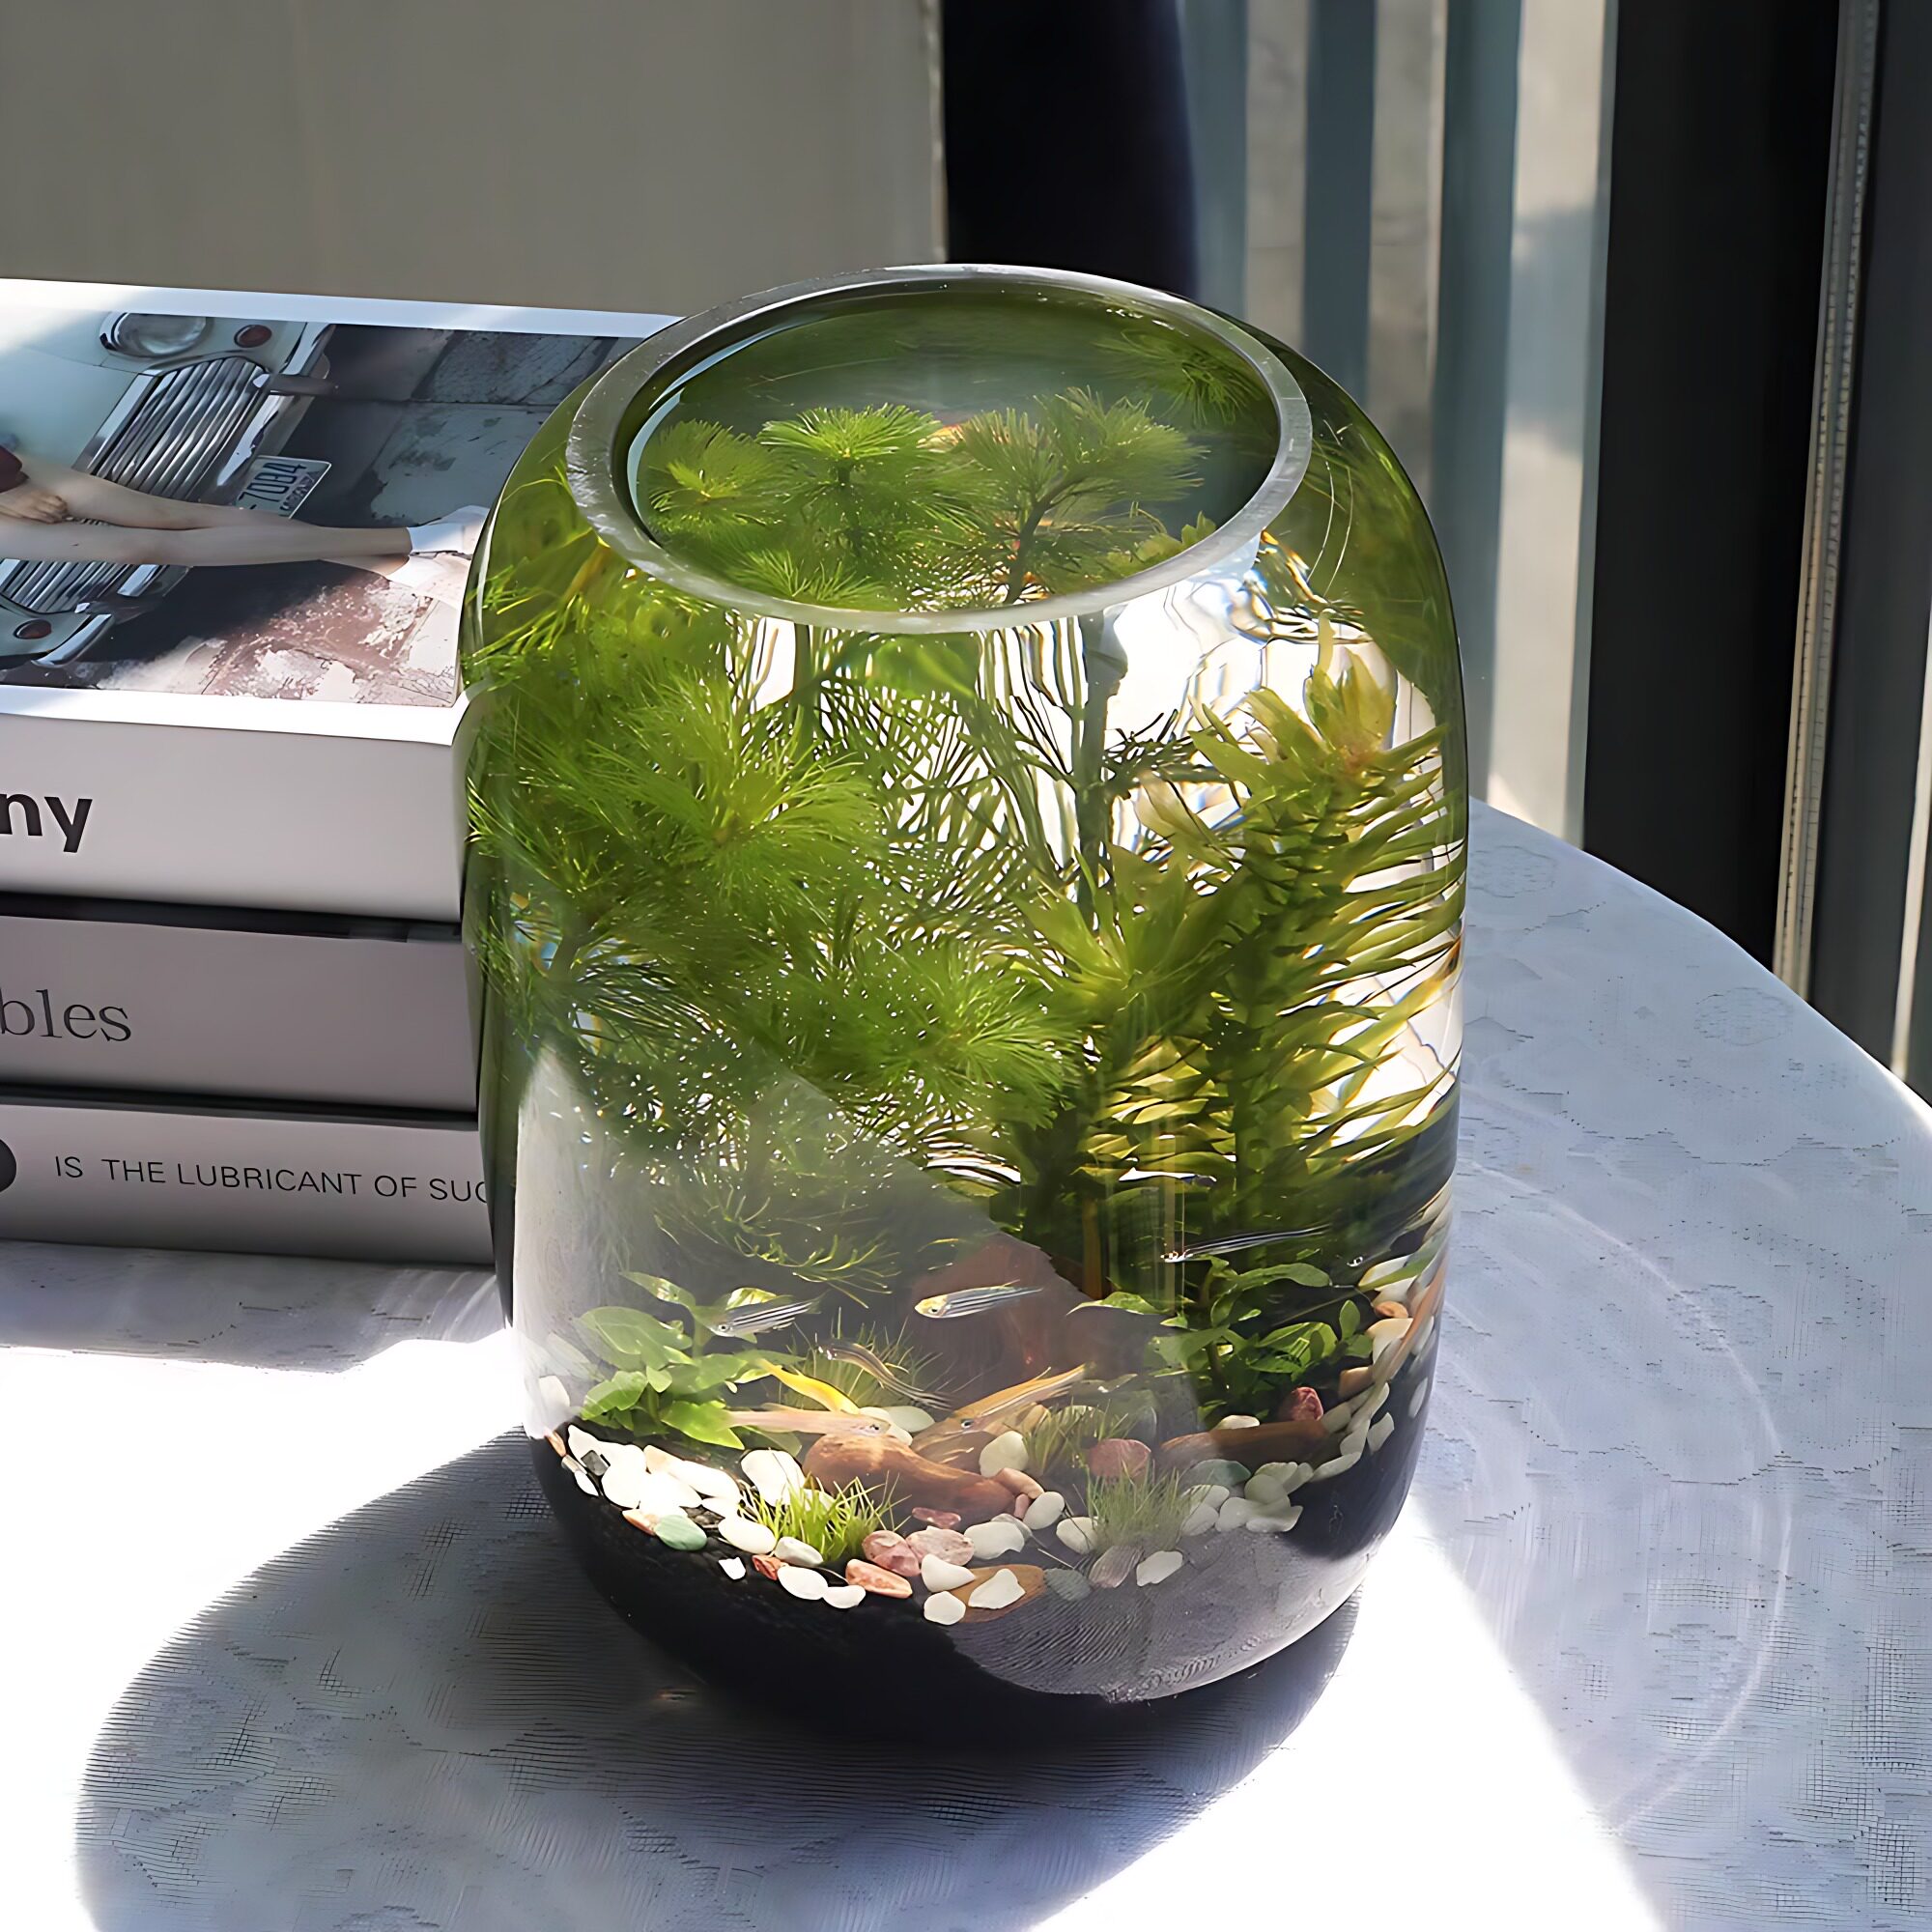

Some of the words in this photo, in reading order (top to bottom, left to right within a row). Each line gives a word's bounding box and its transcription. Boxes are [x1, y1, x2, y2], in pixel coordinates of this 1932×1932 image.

[0, 792, 93, 854] ny
[0, 987, 132, 1042] bles
[55, 1155, 84, 1179] IS
[101, 1158, 166, 1184] THE
[177, 1162, 362, 1196] LUBRICANT
[374, 1175, 418, 1198] OF
